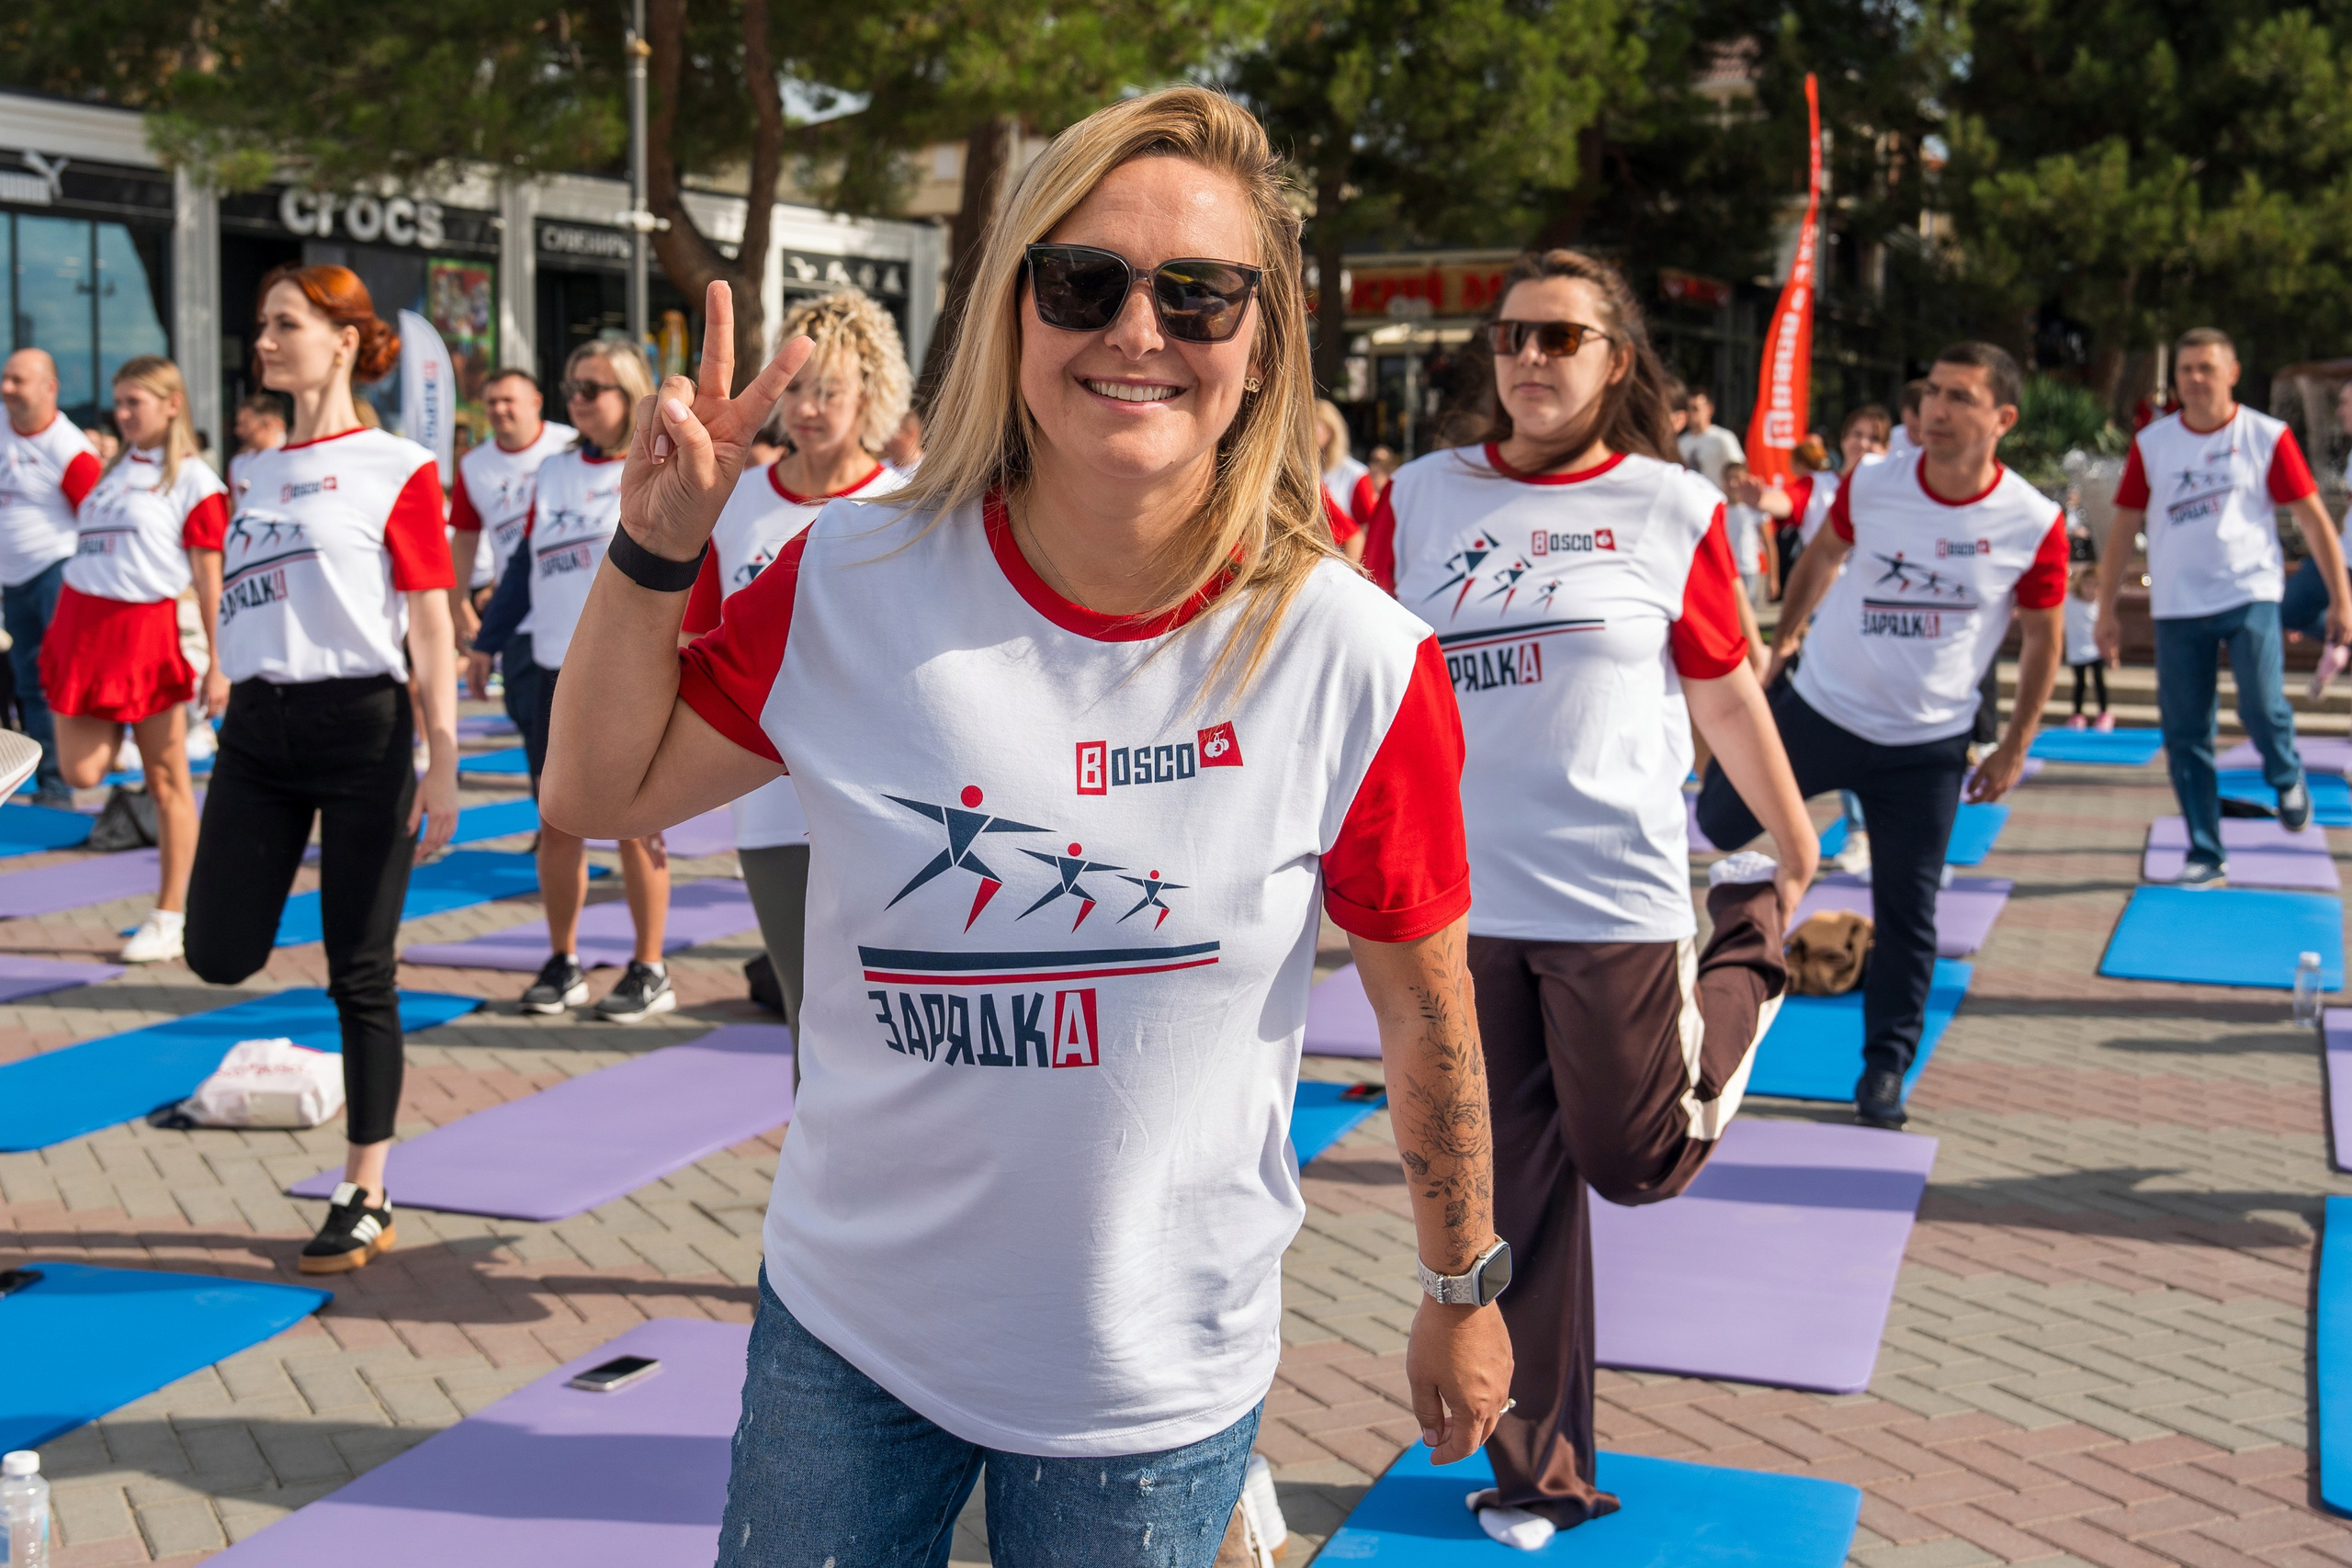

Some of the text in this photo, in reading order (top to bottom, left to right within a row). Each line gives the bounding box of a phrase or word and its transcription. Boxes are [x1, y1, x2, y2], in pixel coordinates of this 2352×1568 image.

[1532, 530, 1592, 556] BOSCO
[1447, 642, 1543, 692] РЯДКА
[1076, 740, 1196, 795] BOSCO
[867, 988, 1100, 1068] ЗАРЯДКА
